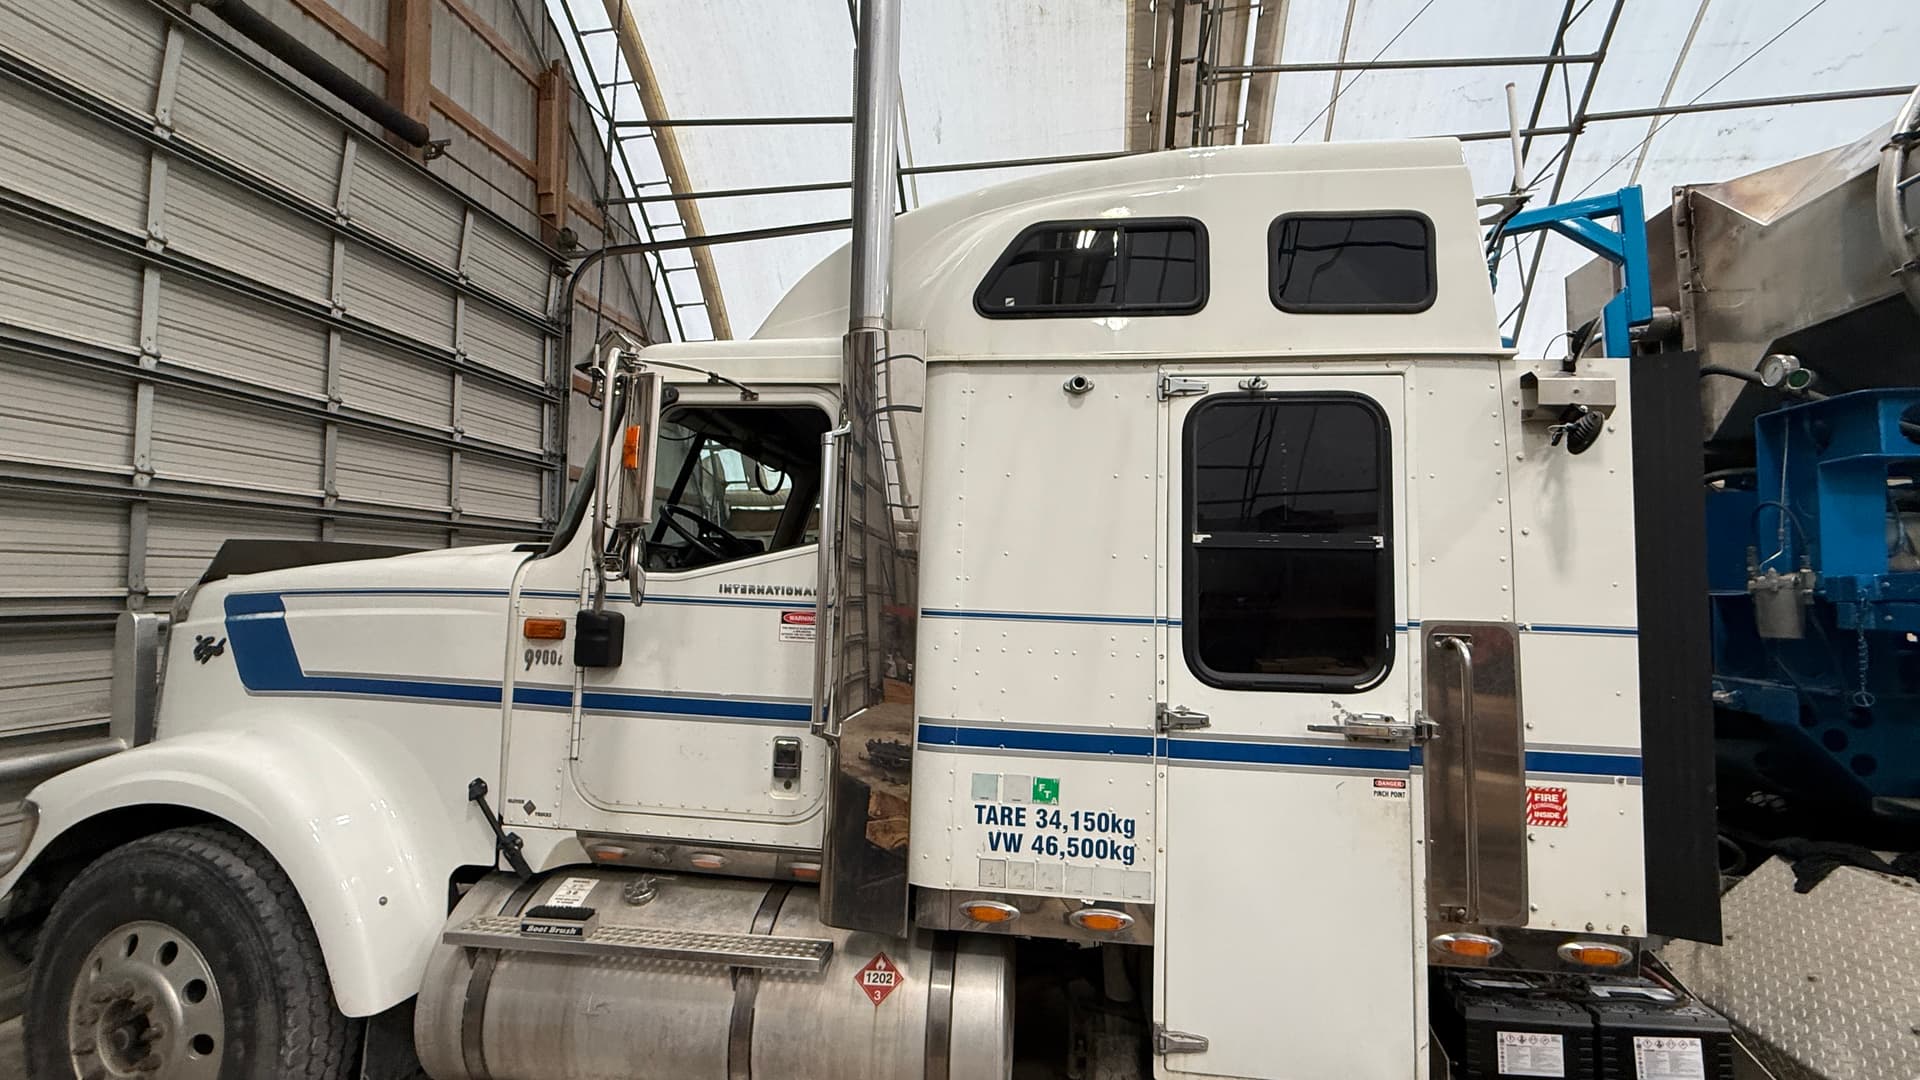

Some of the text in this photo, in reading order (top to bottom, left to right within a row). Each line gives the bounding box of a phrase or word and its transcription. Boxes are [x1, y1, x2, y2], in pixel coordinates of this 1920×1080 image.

[1373, 790, 1406, 799] PINCH POINT
[1534, 793, 1560, 803] FIRE
[1533, 811, 1561, 820] INSIDE
[974, 804, 1136, 840] TARE 34,150kg
[988, 831, 1136, 866] VW 46,500kg
[526, 925, 577, 935] Boot Brush
[866, 972, 893, 984] 1202
[873, 990, 881, 1001] 3
